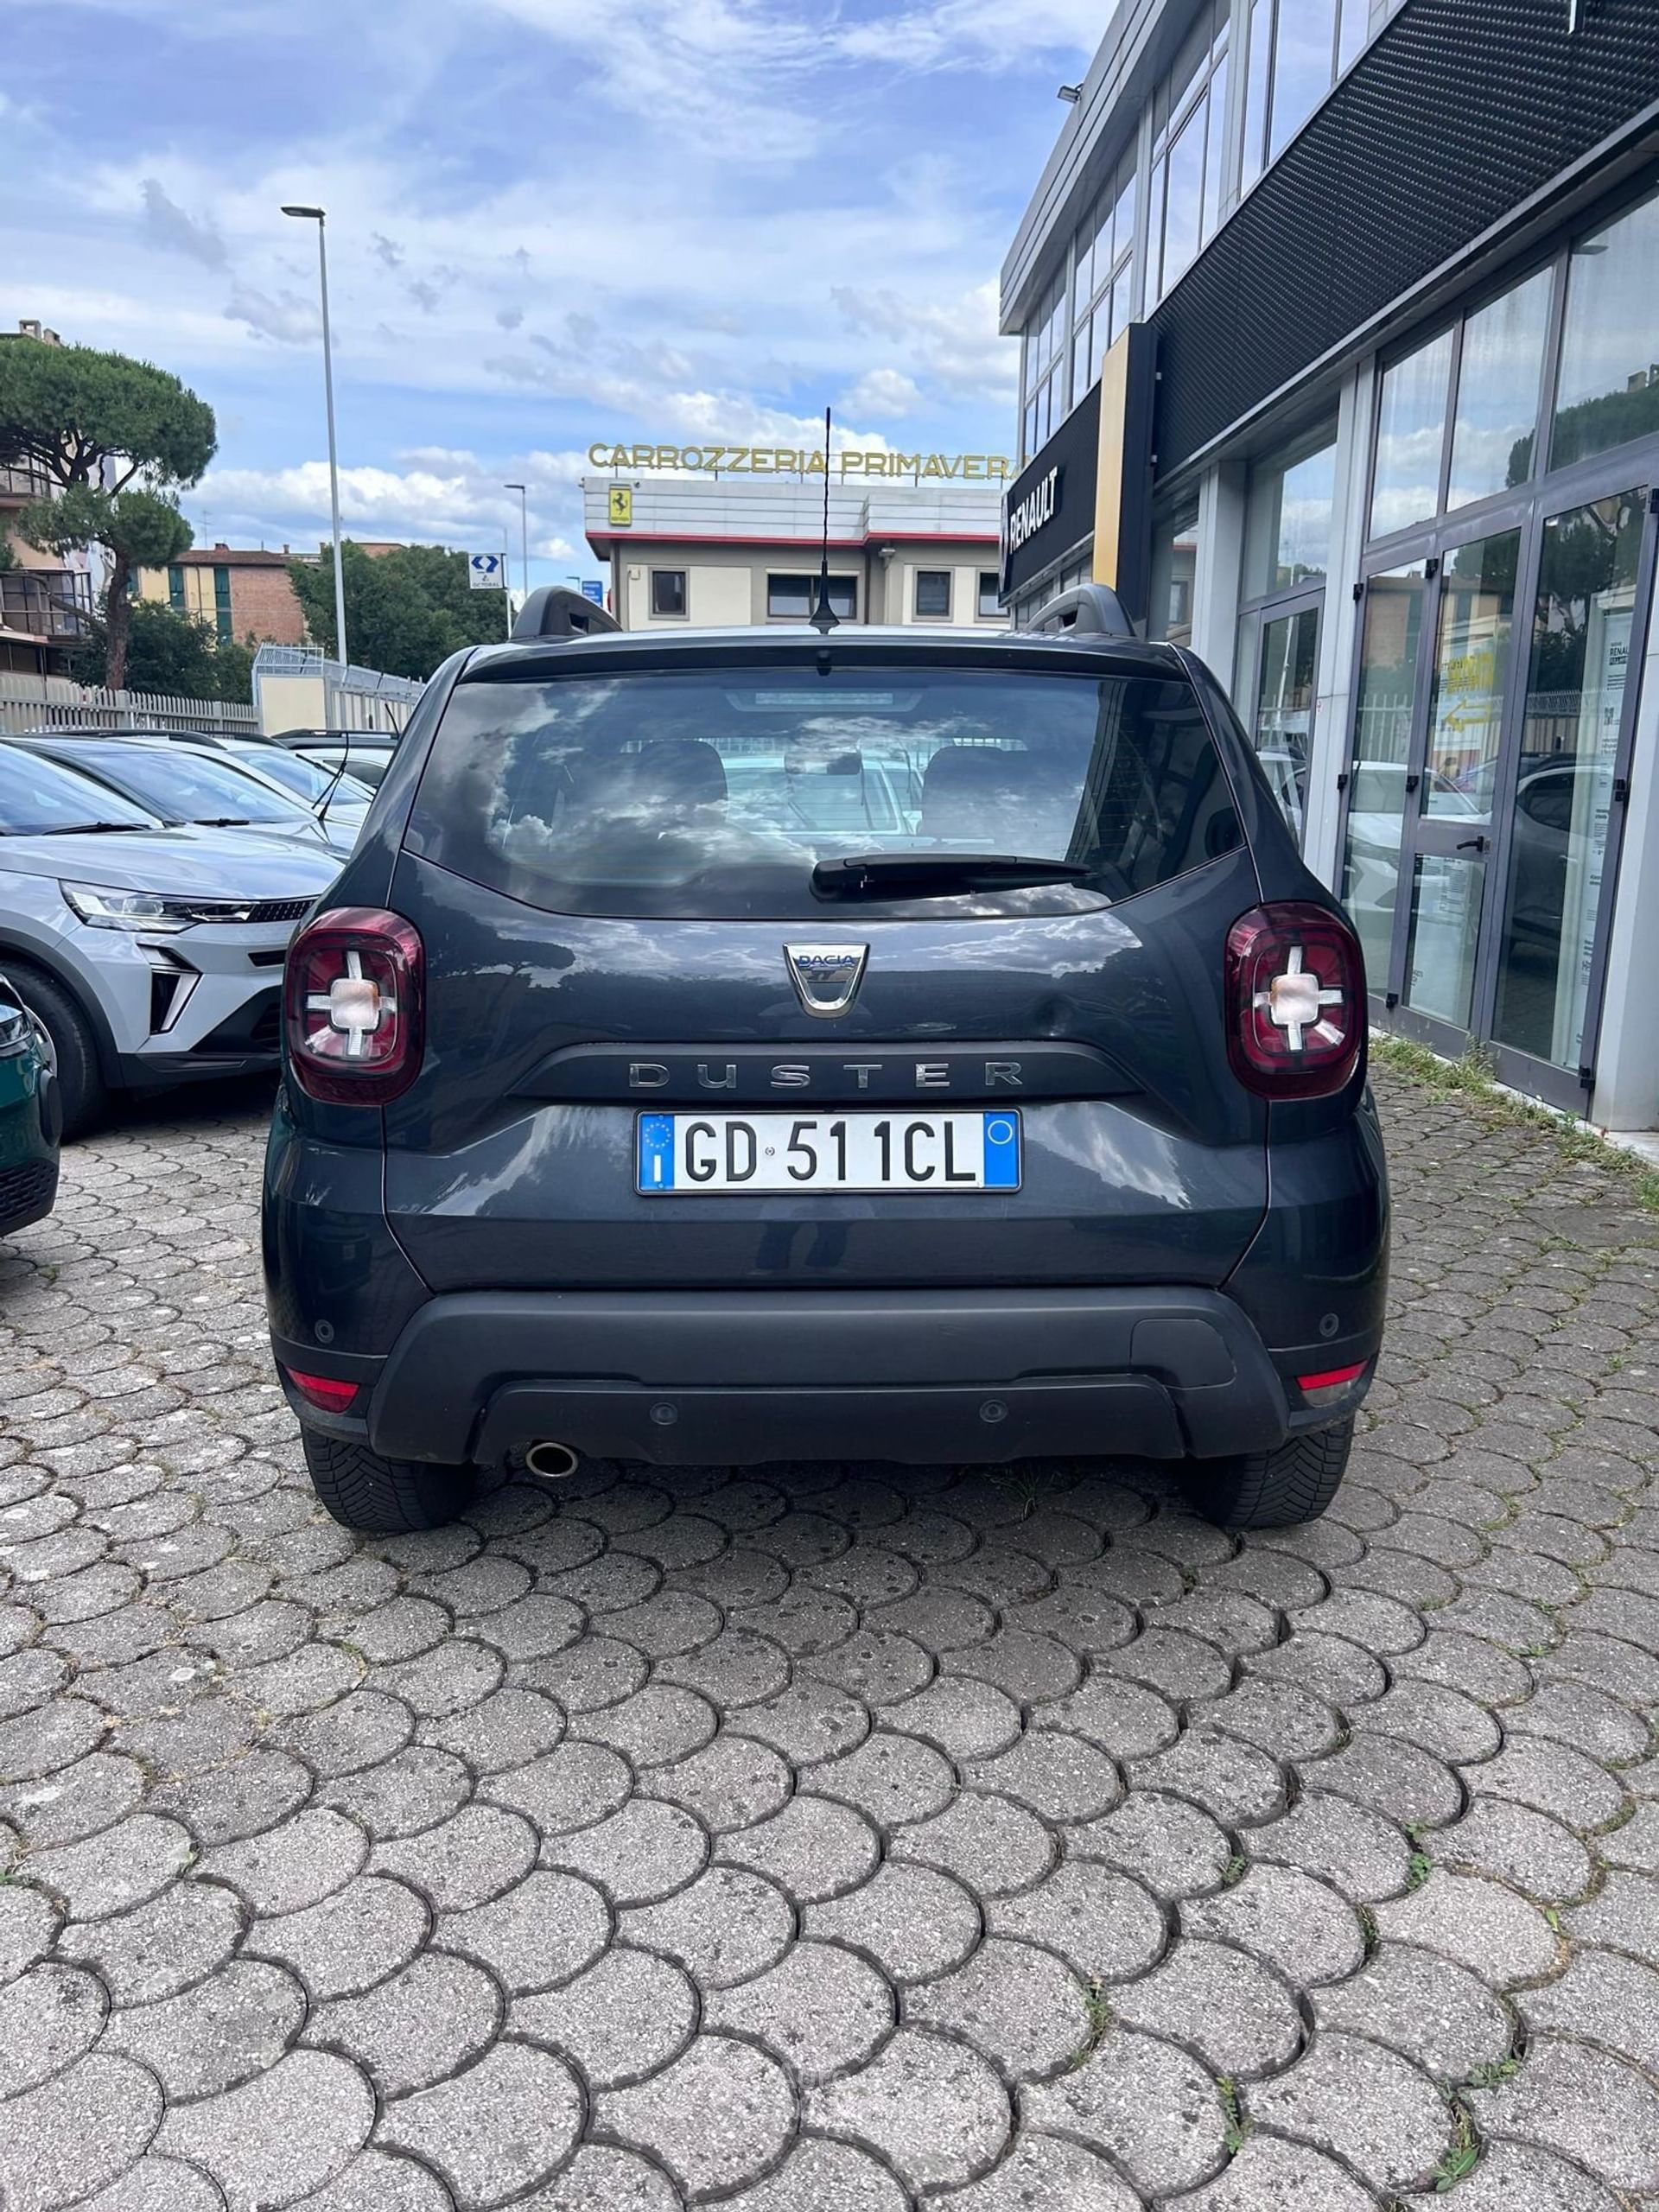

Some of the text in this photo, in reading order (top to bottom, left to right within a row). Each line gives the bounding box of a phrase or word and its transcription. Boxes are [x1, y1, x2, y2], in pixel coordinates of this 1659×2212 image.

[588, 442, 827, 474] CARROZZERIA
[1009, 466, 1058, 555] RENAULT
[798, 954, 856, 968] DACIA
[628, 1062, 1023, 1090] DUSTER
